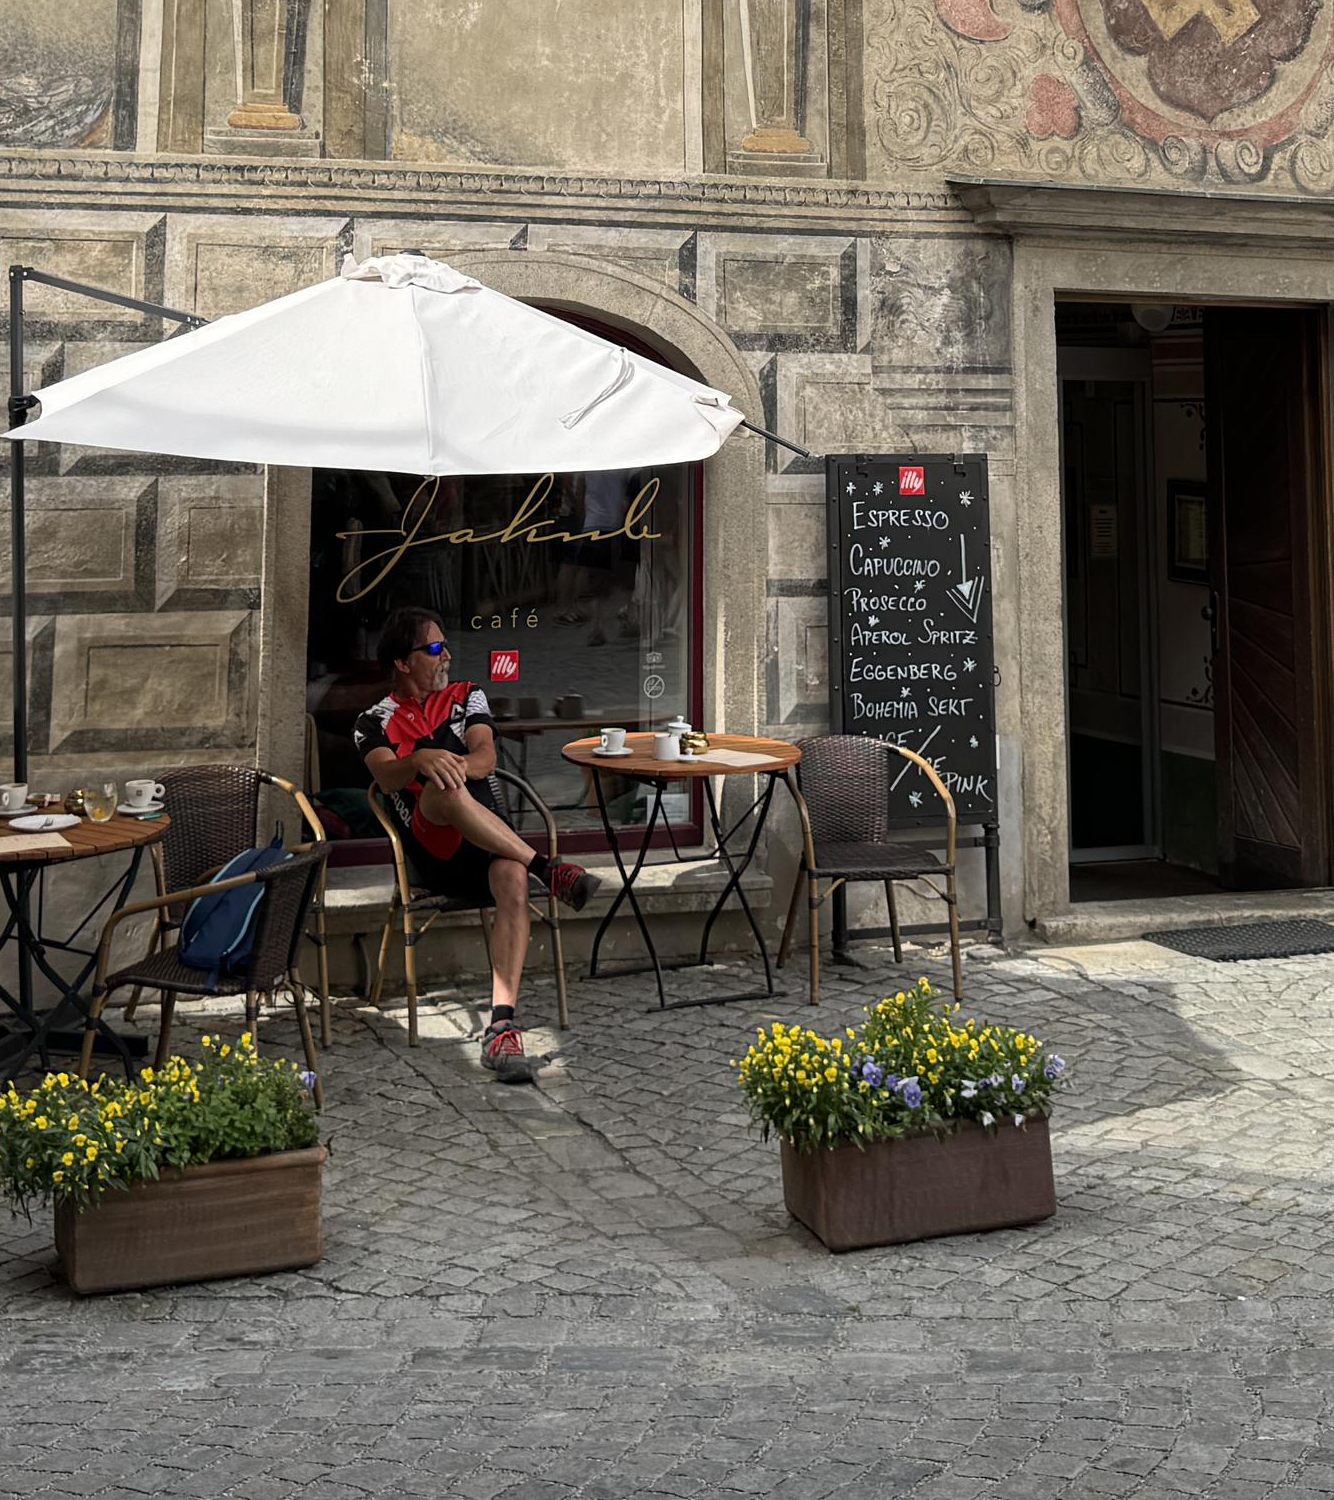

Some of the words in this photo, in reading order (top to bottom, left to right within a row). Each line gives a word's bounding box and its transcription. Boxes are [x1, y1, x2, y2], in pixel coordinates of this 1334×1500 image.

[900, 470, 924, 493] illy
[852, 501, 949, 530] ESPRESSO
[850, 543, 940, 578] CAPUCCINO
[844, 587, 927, 613] PROSECCO
[471, 607, 539, 630] café
[850, 622, 912, 646] APEROL
[917, 618, 978, 646] SPRITZ
[492, 655, 517, 678] illy
[849, 657, 958, 682] EGGENBERG
[850, 692, 918, 720] BOHEMIA
[927, 696, 974, 717] SEKT
